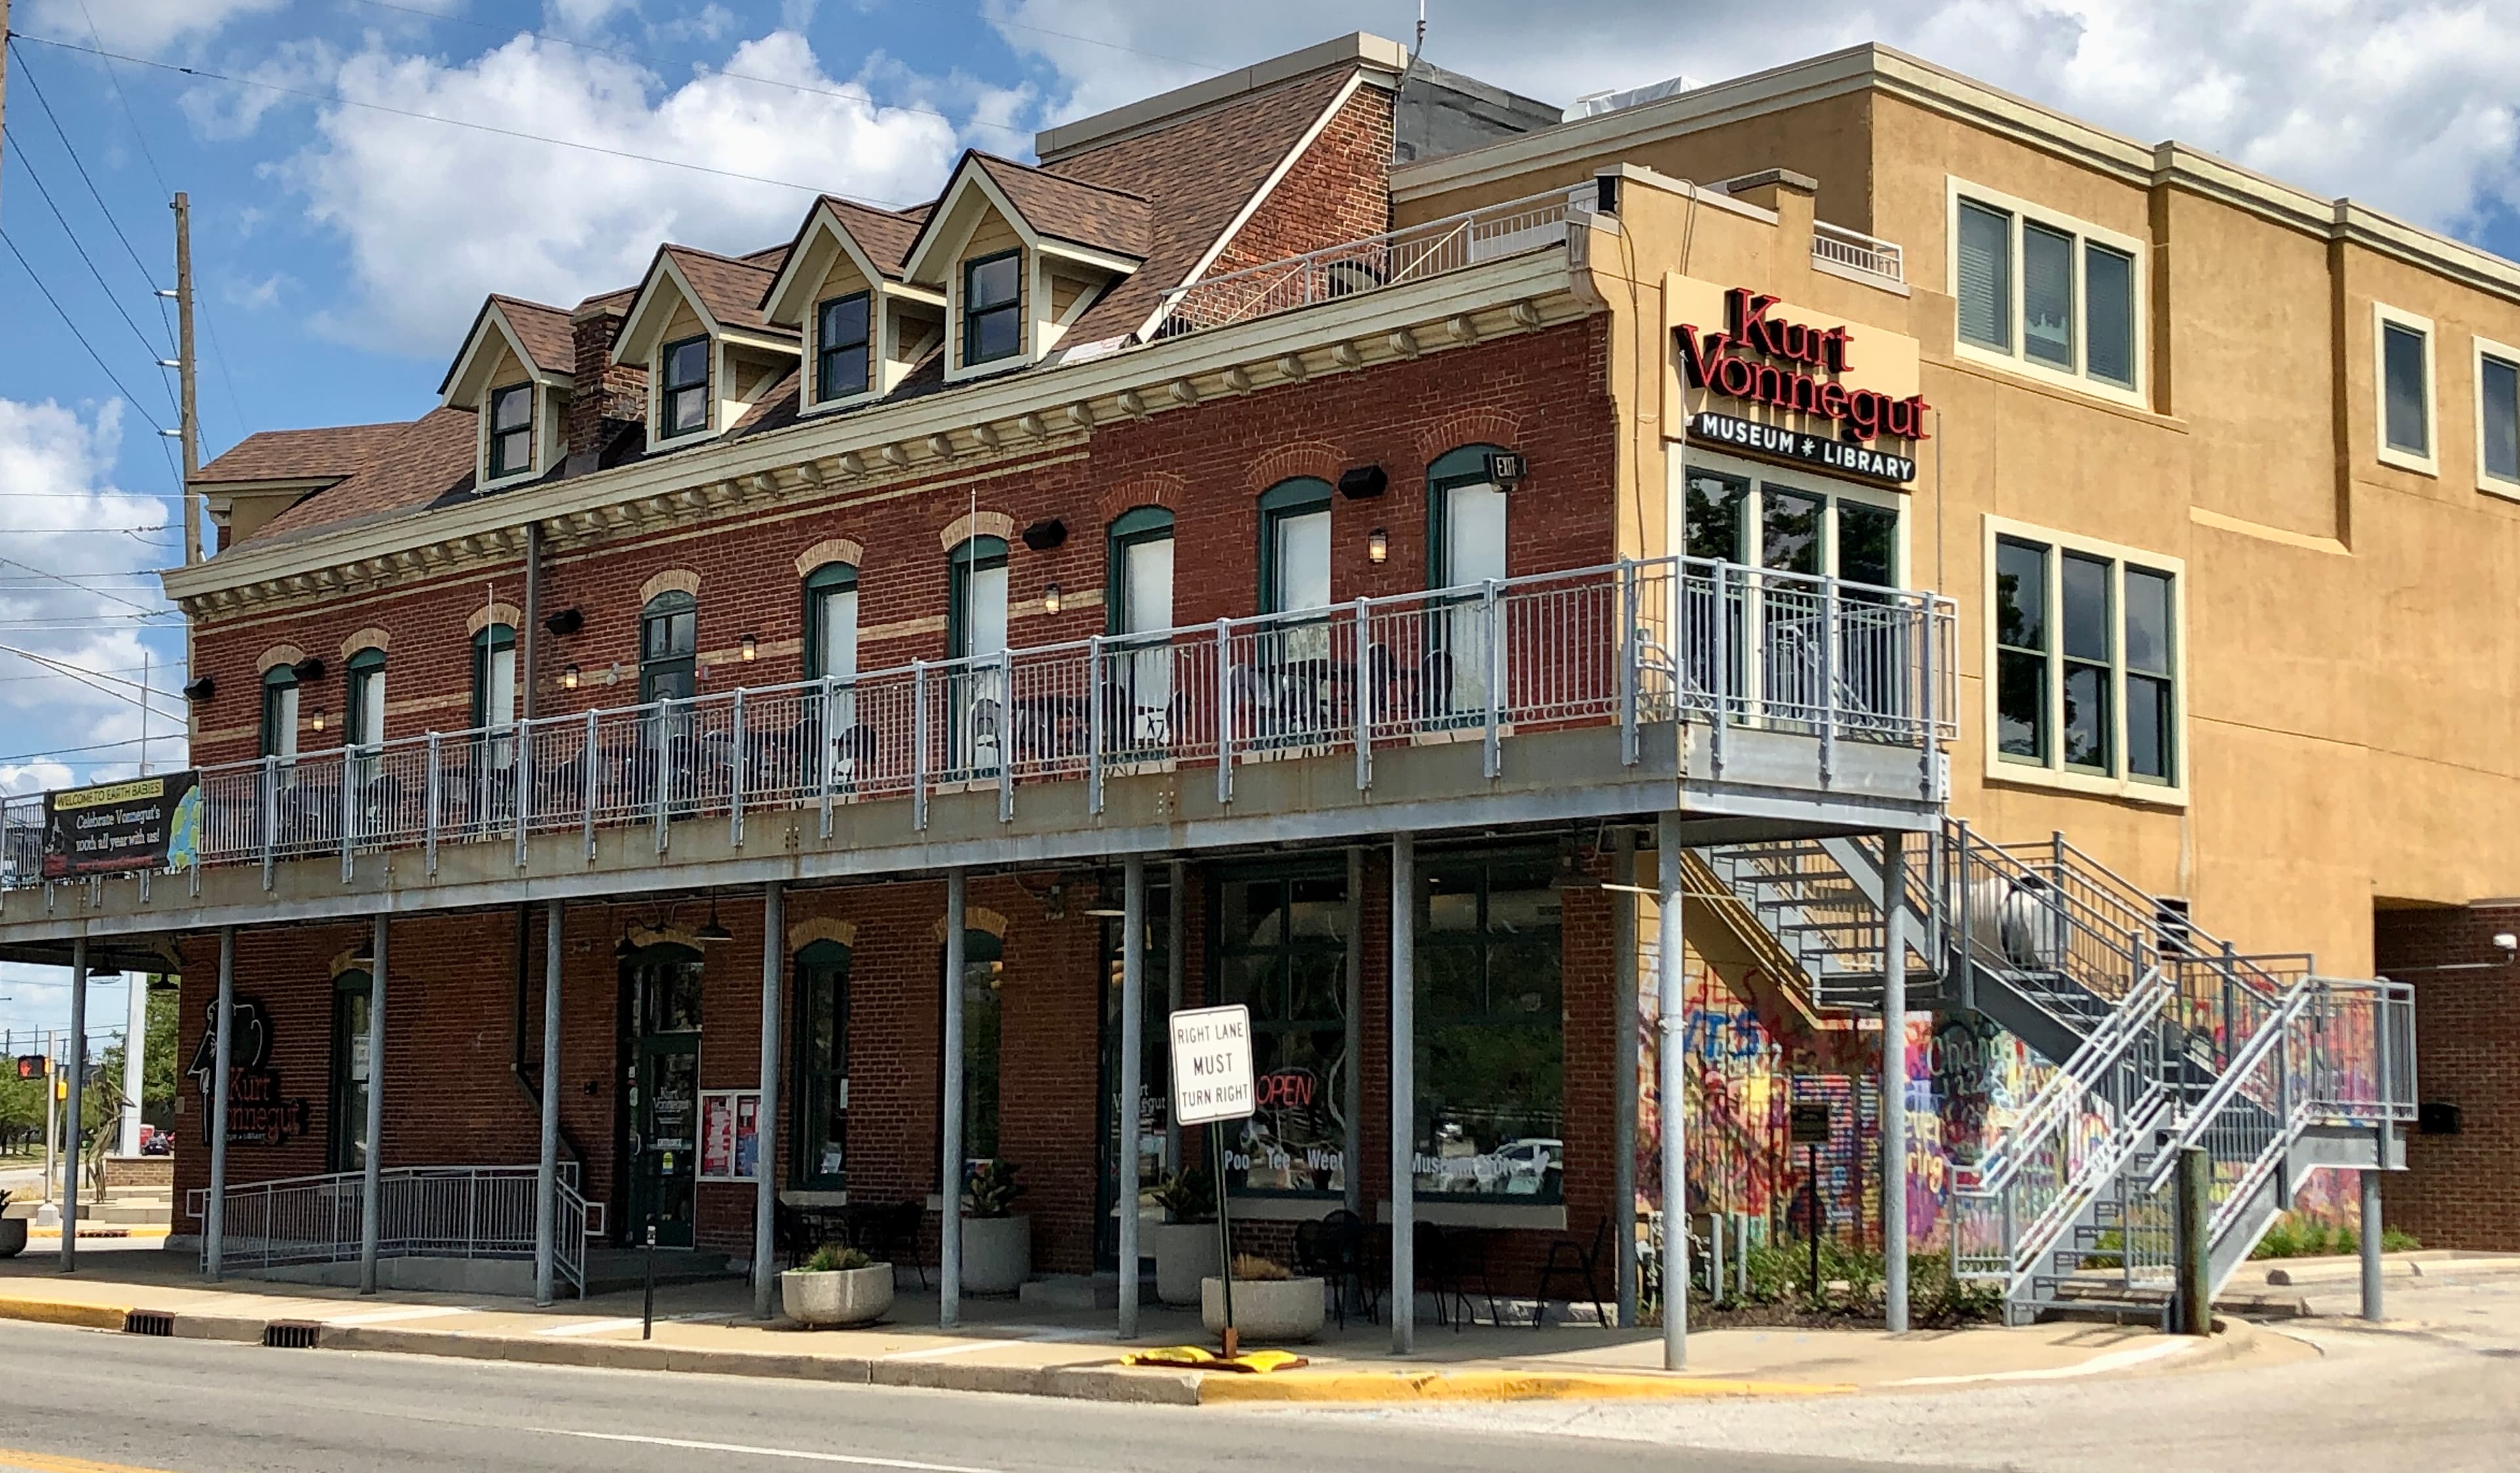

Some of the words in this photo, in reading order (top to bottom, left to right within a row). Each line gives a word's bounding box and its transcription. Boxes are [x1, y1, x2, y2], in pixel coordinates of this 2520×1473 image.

[1725, 287, 1855, 373] Kurt
[1671, 323, 1932, 441] Vonnegut
[1702, 413, 1794, 454] MUSEUM
[1823, 442, 1912, 480] LIBRARY
[1496, 456, 1516, 477] EXIT
[56, 793, 93, 807] WELCOME
[94, 790, 105, 802] TO
[106, 786, 130, 800] EARTH
[76, 811, 115, 830] Celebrate
[116, 804, 161, 825] Vonnegut's
[98, 833, 109, 850] all
[110, 837, 127, 852] year
[128, 827, 146, 846] with
[146, 827, 160, 843] us!
[1177, 1026, 1210, 1045] RIGHT
[1215, 1022, 1244, 1040] LANE
[1194, 1052, 1232, 1076] MUST
[1182, 1089, 1211, 1108] TURN
[1216, 1084, 1248, 1103] RIGHT
[1256, 1075, 1312, 1106] OPEN
[1225, 1150, 1250, 1171] Poo
[1267, 1149, 1290, 1170] Tee
[1307, 1150, 1344, 1171] Weet
